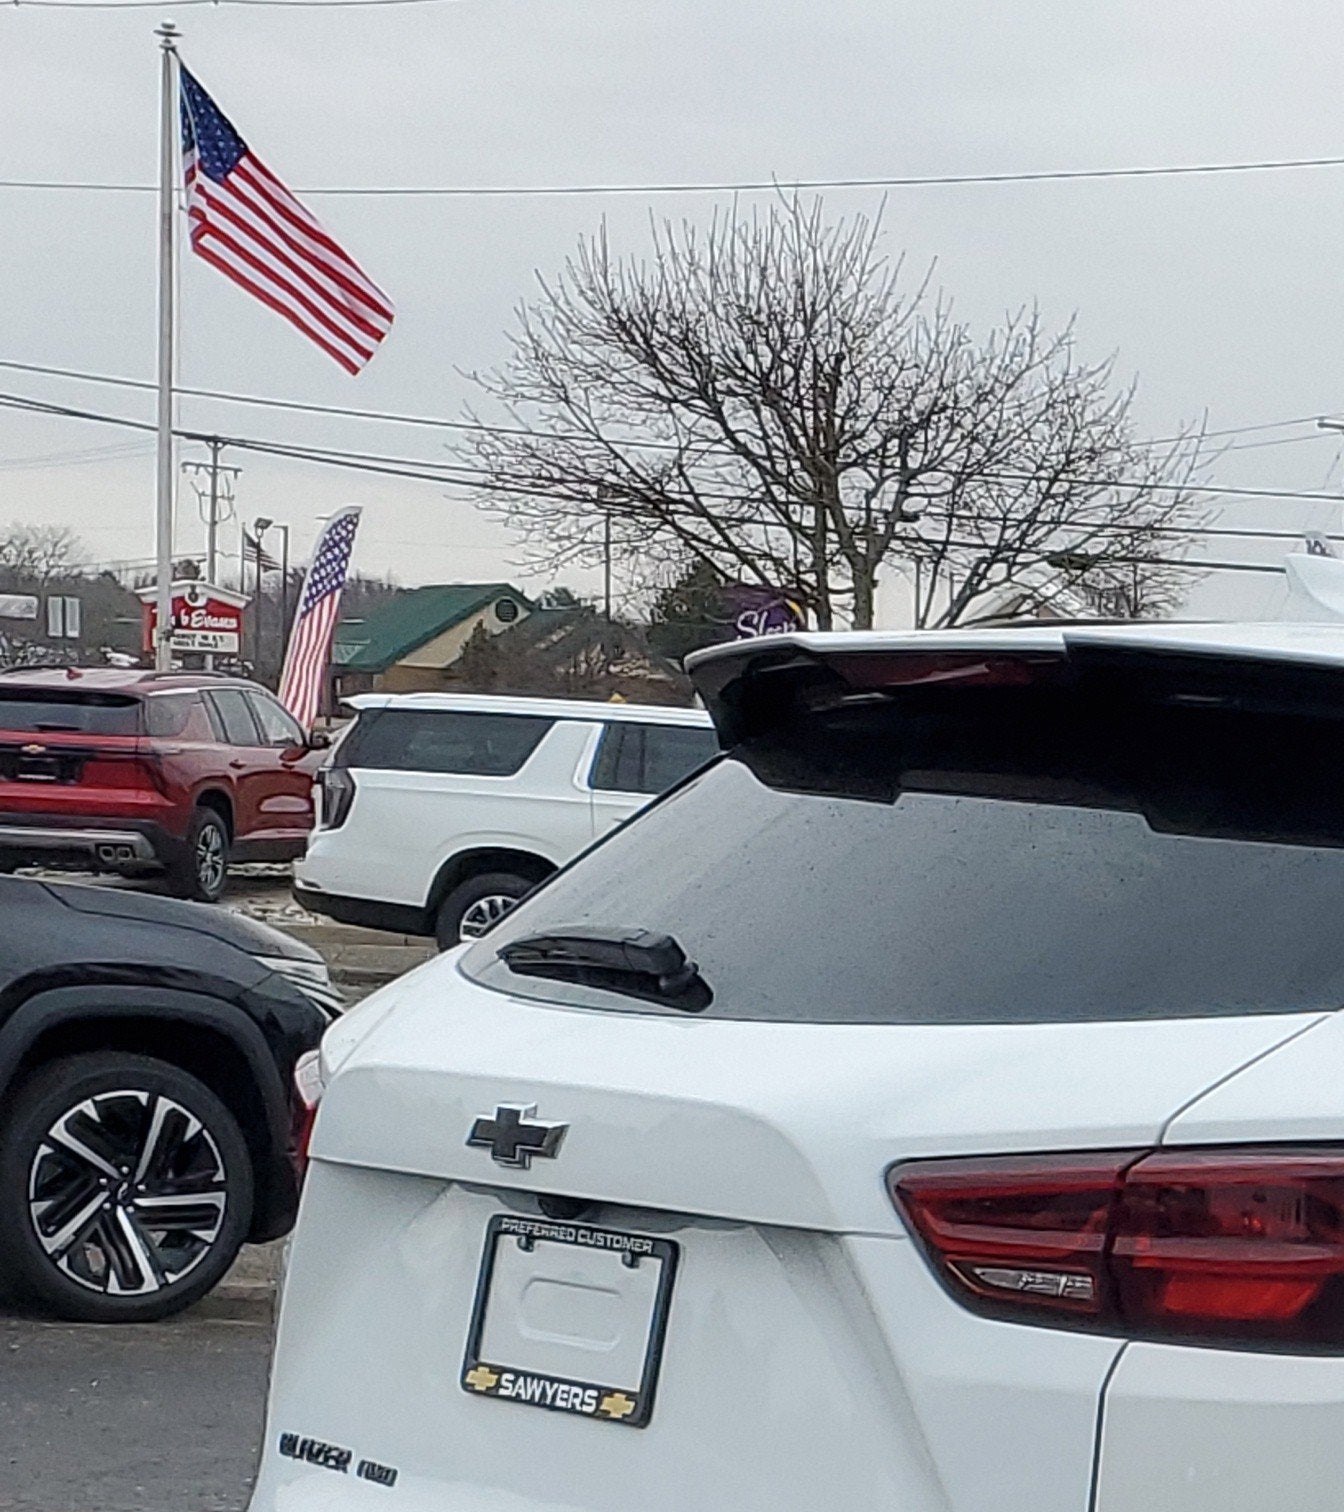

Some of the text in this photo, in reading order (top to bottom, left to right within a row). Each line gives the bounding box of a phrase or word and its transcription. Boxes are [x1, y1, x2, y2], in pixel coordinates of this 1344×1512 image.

[501, 1218, 653, 1253] PREFERRED CUSTOMER
[498, 1373, 599, 1413] SAWYERS
